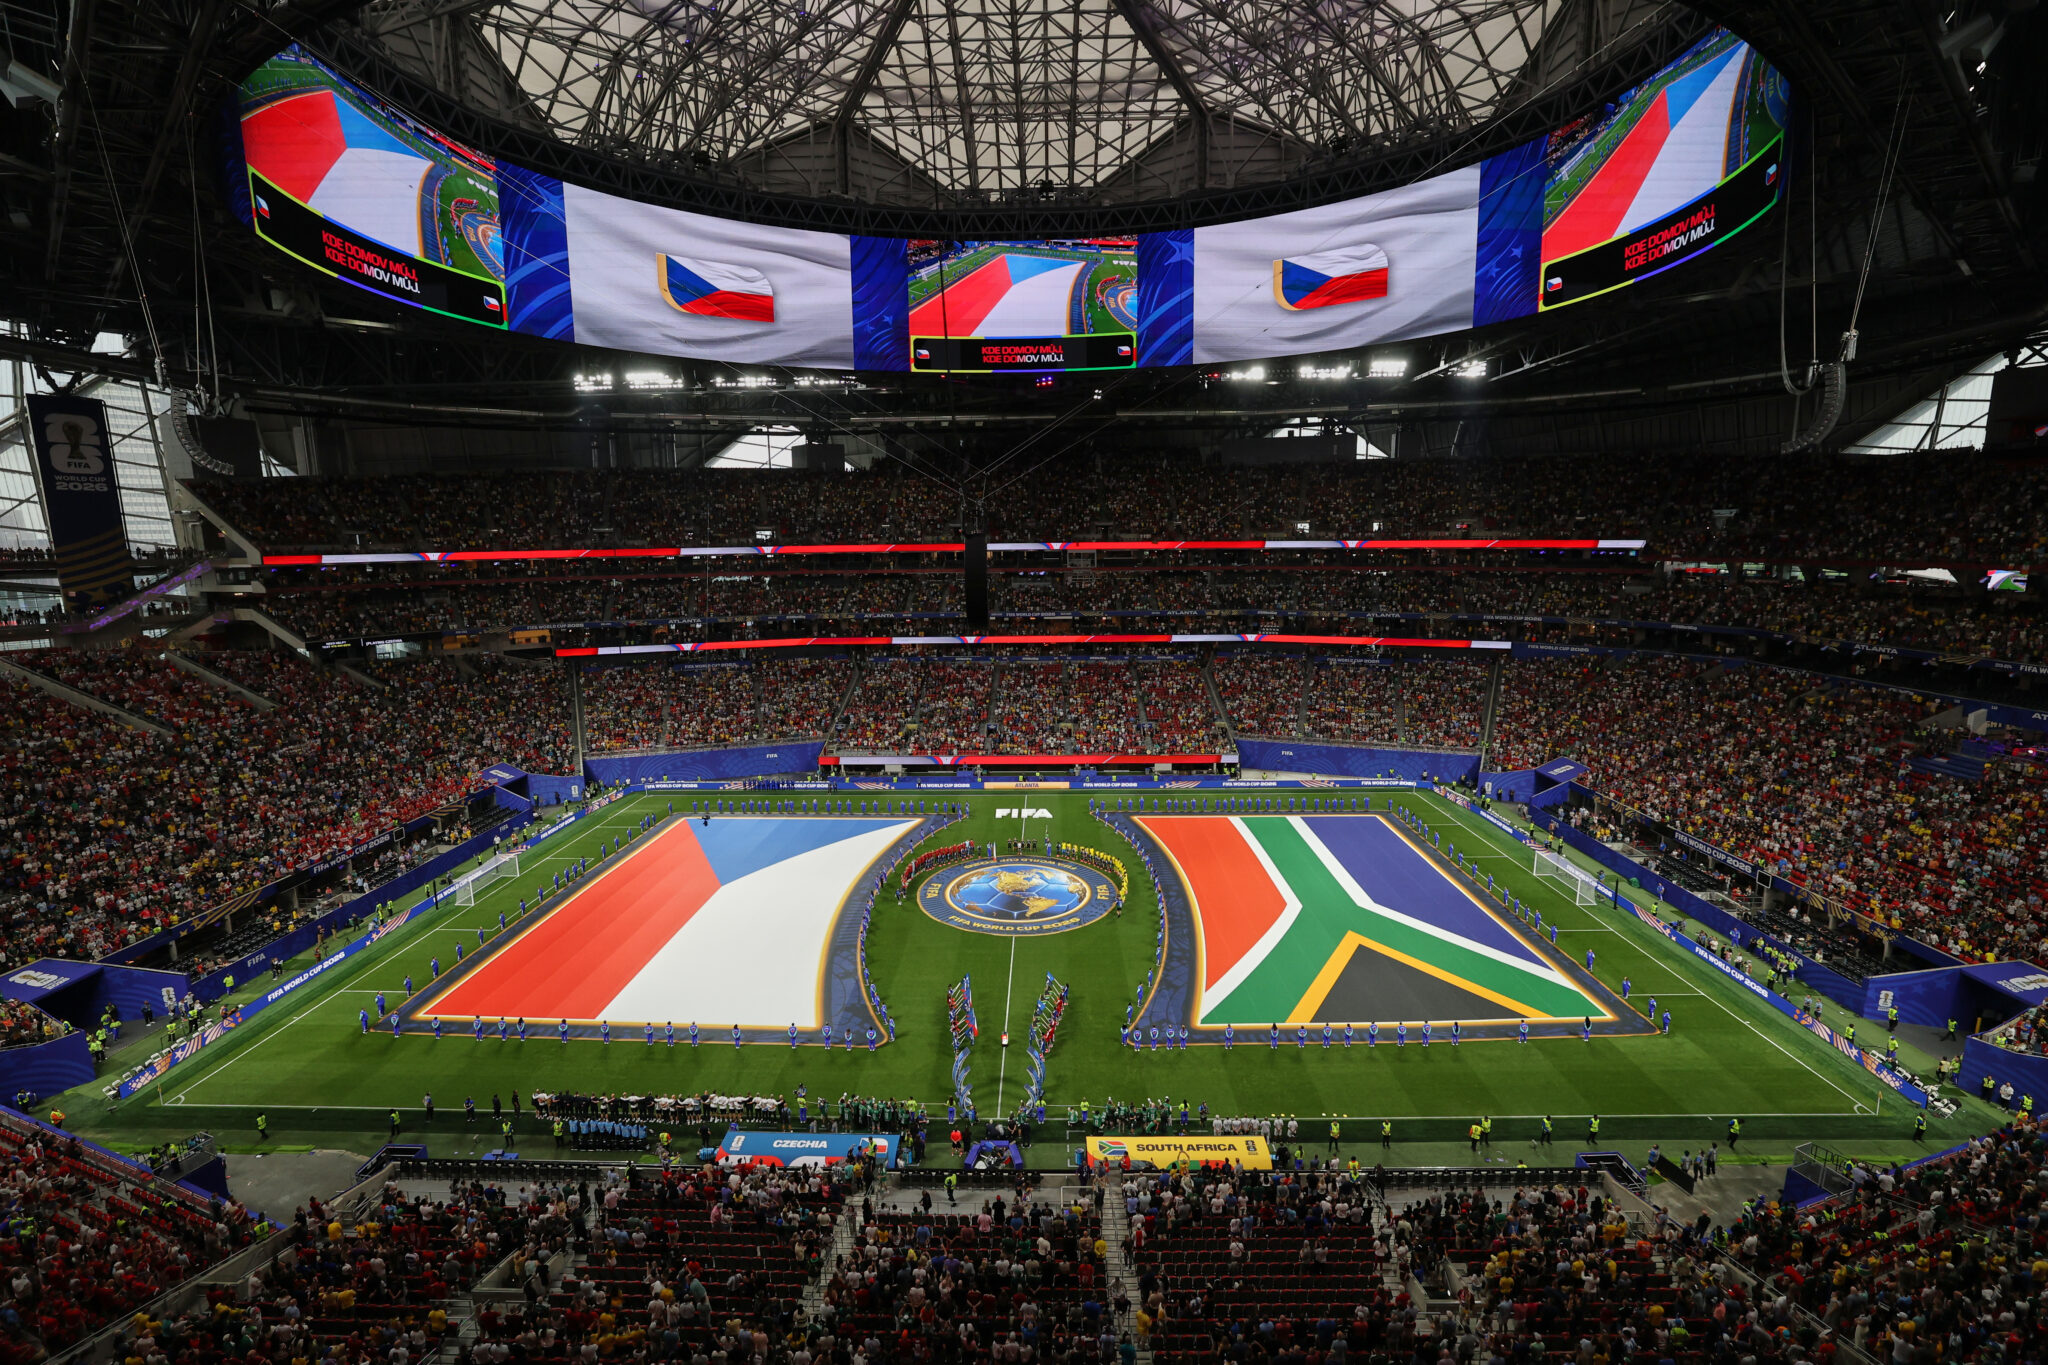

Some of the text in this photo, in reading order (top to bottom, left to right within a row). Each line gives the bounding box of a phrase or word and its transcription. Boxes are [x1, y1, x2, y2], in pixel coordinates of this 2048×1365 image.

[1624, 239, 1647, 258] KDE
[1648, 218, 1690, 248] DOMOV
[321, 230, 344, 251] KDE
[344, 241, 388, 269] DOMOV
[1625, 252, 1648, 271] KDE
[1648, 232, 1690, 262] DOMOV
[324, 246, 347, 266] KDE
[348, 256, 390, 283] DOMOV
[981, 346, 1000, 354] KDE
[1002, 346, 1039, 354] DOMOV
[983, 355, 1002, 363] KDE
[1003, 355, 1040, 363] DOMOV
[67, 461, 91, 469] FIFA
[56, 482, 109, 492] 2026
[1854, 643, 1898, 655] ATLANTA
[2020, 664, 2039, 673] FIFA
[995, 808, 1053, 819] FIFA
[499, 824, 509, 832] FIFA
[313, 863, 330, 874] FIFA
[355, 845, 368, 855] CUP
[368, 834, 390, 848] 2026
[1674, 832, 1752, 873] FIFA WORLD CUP 2026
[926, 883, 942, 898] FIFA
[1096, 884, 1110, 900] FIFA
[948, 915, 971, 926] FIFA
[972, 921, 1014, 931] WORLD
[1041, 917, 1081, 930] 2026
[247, 952, 266, 967] FIFA
[1786, 951, 1804, 968] FIFA
[267, 951, 346, 1002] FIFA WORLD CUP 2026
[1695, 946, 1769, 998] FIFA WORLD CUP 2026
[772, 1139, 828, 1149] CZECHIA
[1136, 1143, 1237, 1152] SOUTH AFRICA
